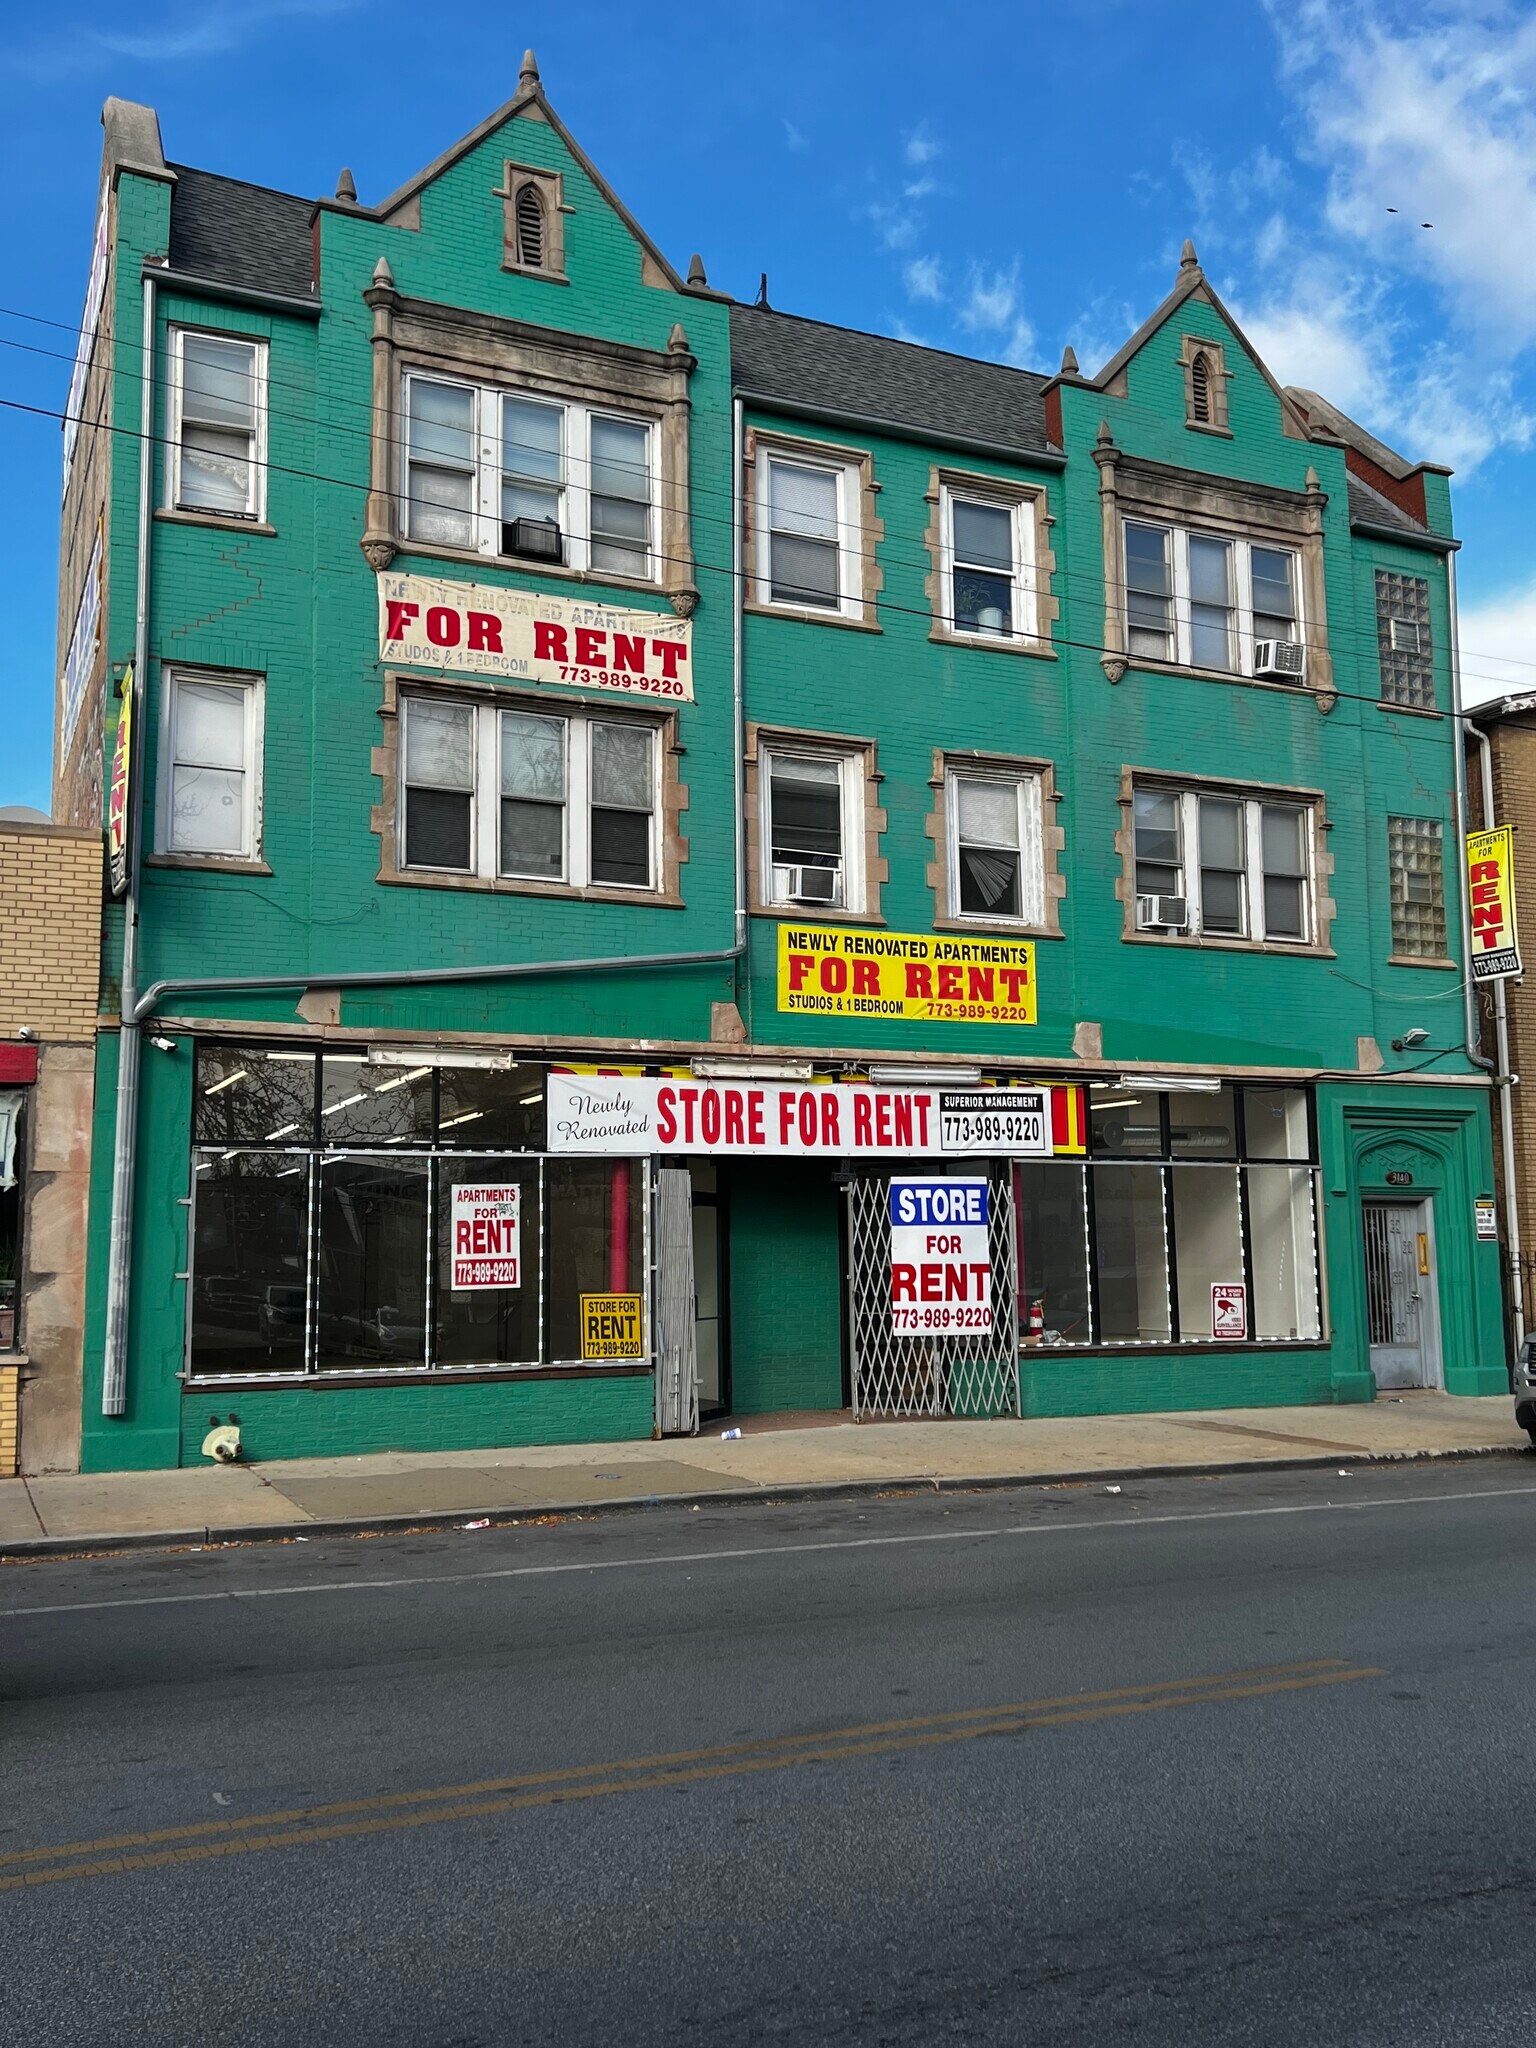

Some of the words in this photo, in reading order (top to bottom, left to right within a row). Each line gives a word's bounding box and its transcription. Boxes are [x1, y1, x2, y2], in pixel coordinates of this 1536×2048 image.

[386, 600, 503, 653] FOR
[534, 621, 687, 679] RENT
[559, 665, 684, 696] 773-989-9220
[1478, 847, 1493, 858] FOR
[1470, 860, 1503, 950] RENT
[788, 932, 839, 952] NEWLY
[844, 936, 928, 958] RENOVATED
[934, 943, 1028, 964] APARTMENTS
[788, 954, 881, 996] FOR
[905, 962, 1028, 1003] RENT
[788, 994, 833, 1010] STUDIOS
[837, 998, 843, 1011] &
[846, 999, 852, 1011] 1
[854, 999, 904, 1014] BEDROOM
[927, 1003, 1027, 1020] 773-989-9220
[569, 1091, 634, 1118] Newly
[944, 1096, 984, 1108] SUPERIOR
[985, 1096, 1038, 1108] MANAGEMENT
[556, 1114, 650, 1140] Renovated
[657, 1087, 765, 1145] STORE
[779, 1091, 840, 1146] FOR
[854, 1093, 931, 1147] RENT
[944, 1117, 1039, 1141] 773-989-9220
[457, 1189, 516, 1202] APARTMENTS
[899, 1188, 982, 1222] STORE
[474, 1208, 498, 1219] FOR
[457, 1219, 515, 1255] RENT
[926, 1235, 962, 1254] FOR
[457, 1262, 515, 1284] 773-989-9220
[892, 1263, 991, 1302] RENT
[1214, 1288, 1227, 1297] 24
[588, 1301, 617, 1313] STORE
[618, 1301, 635, 1313] FOR
[893, 1307, 992, 1329] 773-989-9220
[588, 1316, 636, 1340] RENT
[586, 1341, 639, 1355] 773-989-9220
